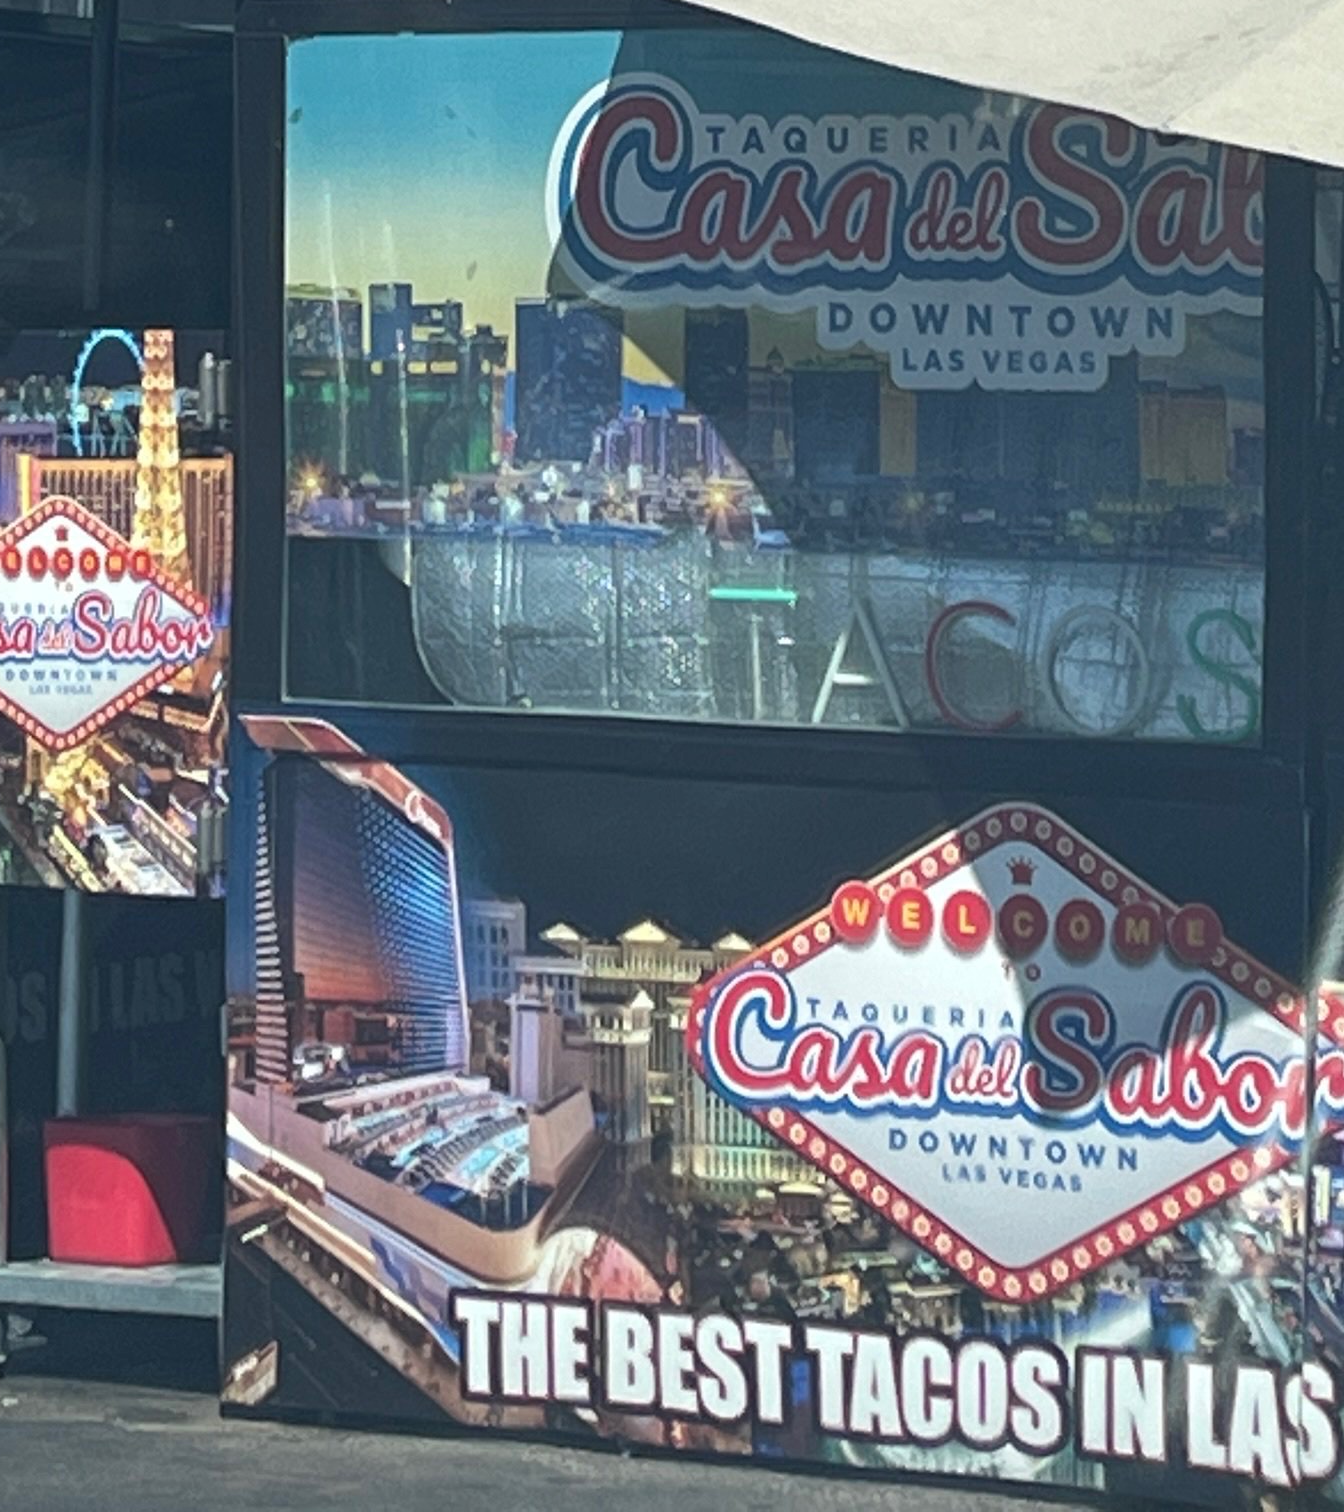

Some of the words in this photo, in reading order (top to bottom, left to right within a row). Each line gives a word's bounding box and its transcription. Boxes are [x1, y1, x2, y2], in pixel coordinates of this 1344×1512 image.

[705, 124, 1002, 155] TAQUERIA
[577, 94, 886, 264] Casa
[908, 171, 1006, 255] del
[828, 300, 1175, 340] DOWNTOWN
[902, 347, 968, 374] LAS
[983, 349, 1098, 376] VEGAS
[73, 586, 212, 660] Sabor
[5, 668, 118, 682] DOWNTOWN
[708, 584, 1262, 745] TACOS
[838, 890, 1216, 953] WELCOME
[806, 997, 1017, 1029] TAQUERIA
[712, 968, 943, 1105] Casa
[950, 1043, 1019, 1099] del
[888, 1128, 1139, 1172] DOWNTOWN
[940, 1163, 992, 1185] LAS
[1000, 1165, 1084, 1193] VEGAS
[456, 1296, 591, 1399] THE
[606, 1308, 792, 1423] BEST
[806, 1328, 1063, 1449] TACOS
[1080, 1353, 1166, 1460] IN
[1187, 1361, 1340, 1486] LAS
